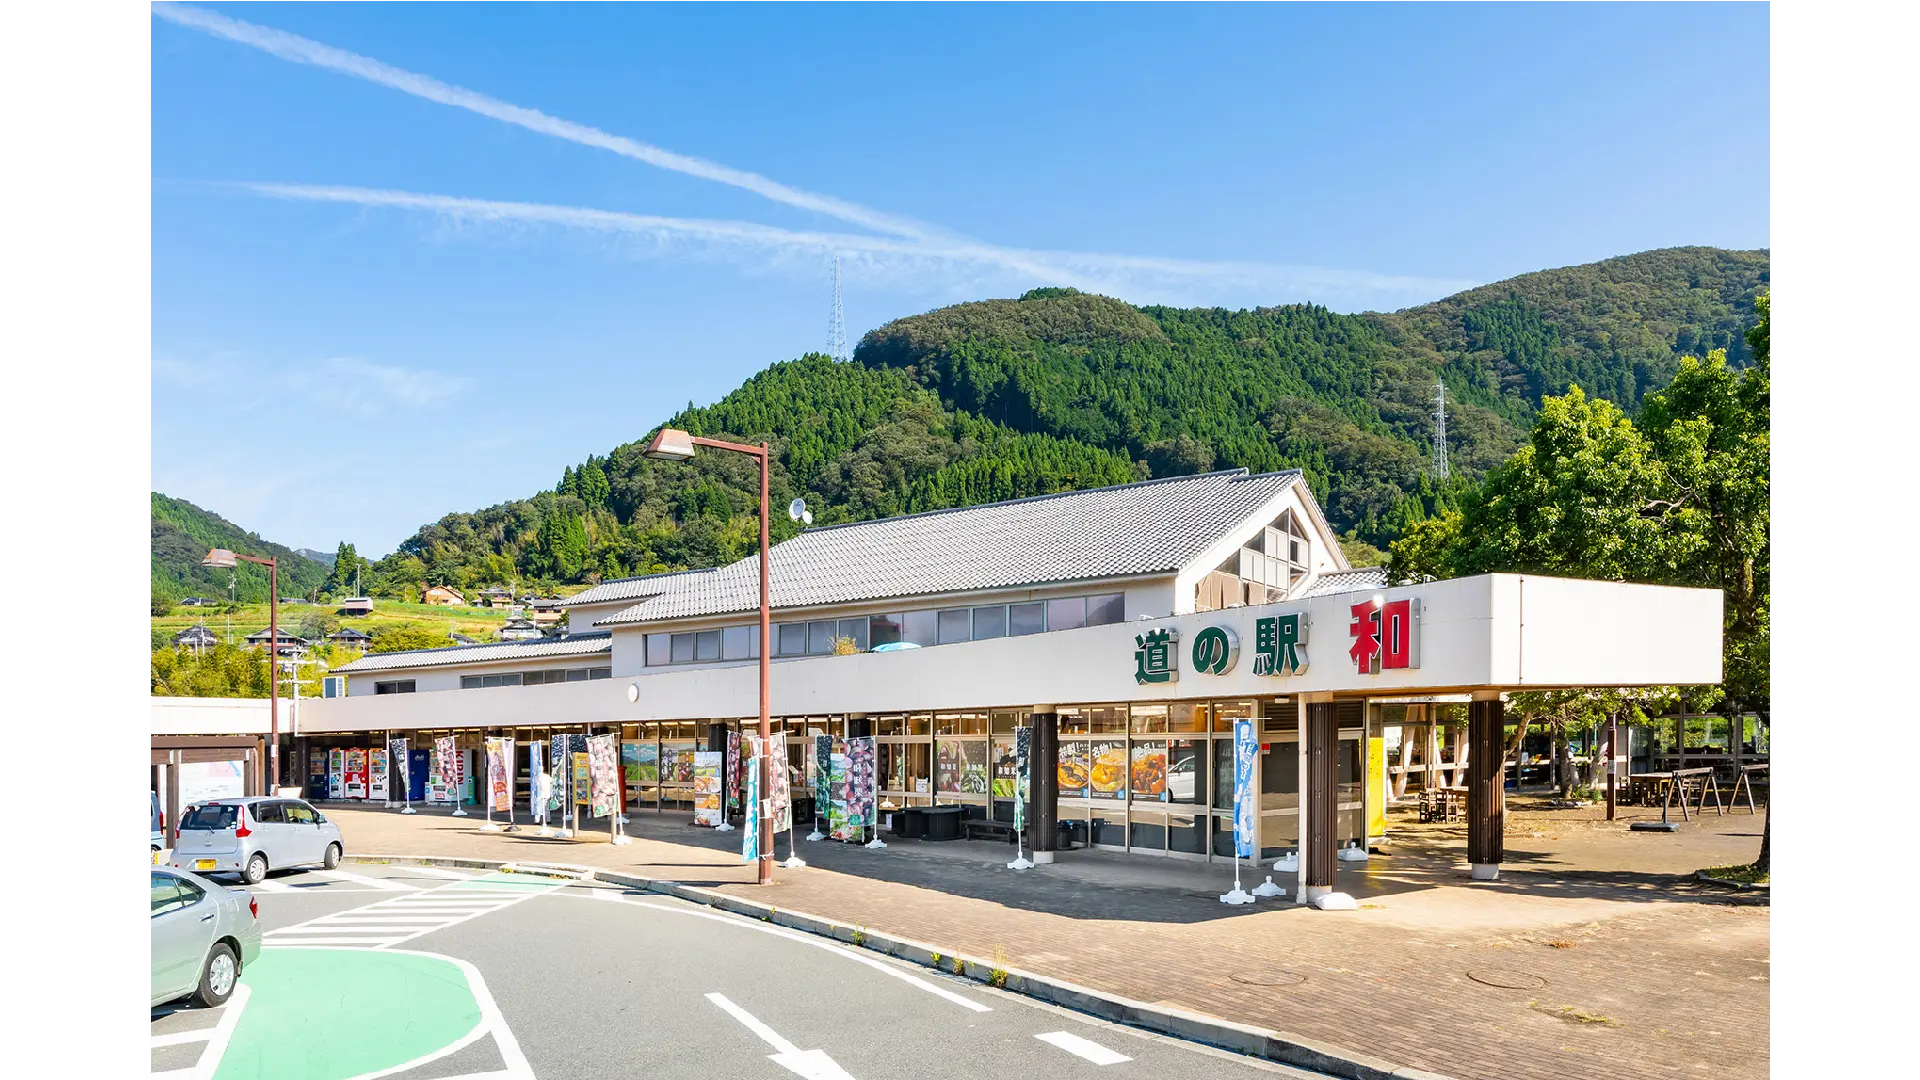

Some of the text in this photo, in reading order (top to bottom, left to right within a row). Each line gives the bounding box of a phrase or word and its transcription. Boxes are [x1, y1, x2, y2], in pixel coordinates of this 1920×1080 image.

[1134, 597, 1420, 685] 道の駅 和
[455, 750, 464, 785] KIRIN
